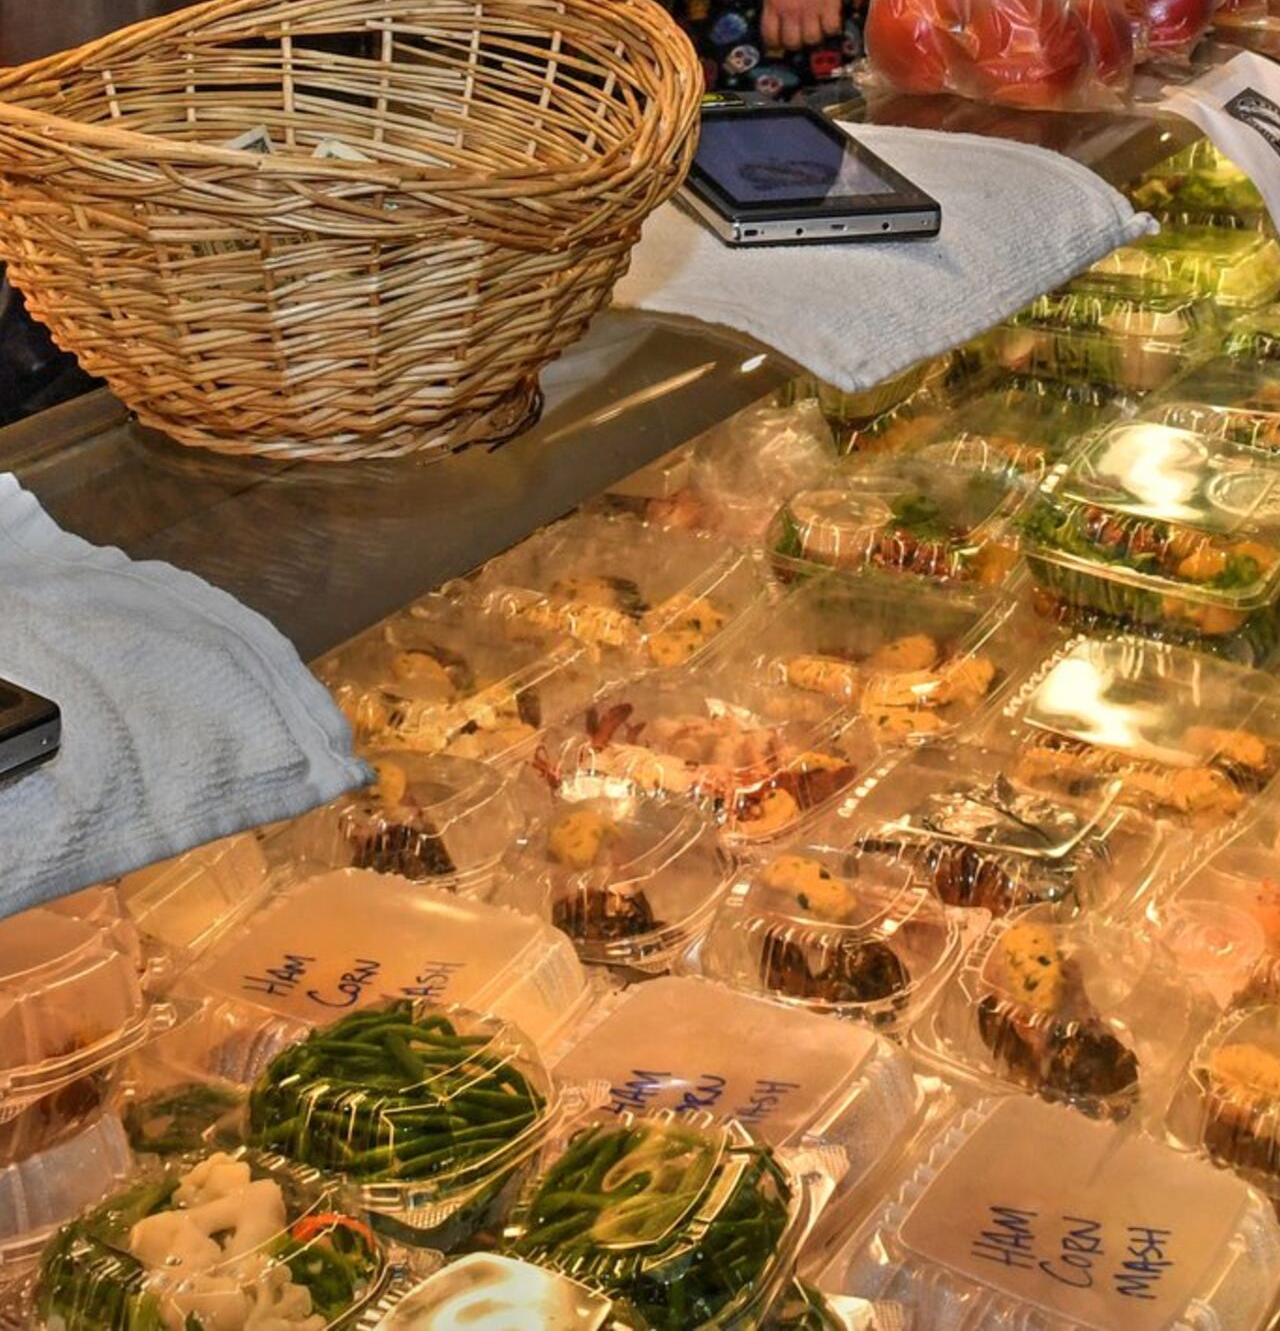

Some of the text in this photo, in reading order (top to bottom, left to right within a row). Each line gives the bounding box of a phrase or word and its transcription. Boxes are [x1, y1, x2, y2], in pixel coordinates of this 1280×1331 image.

[242, 954, 317, 997] HAM
[306, 958, 381, 1008] CORN
[381, 960, 466, 1002] ASH
[733, 1080, 801, 1123] ASH
[971, 1206, 1038, 1269] HAM
[1038, 1216, 1104, 1288] CORN
[1114, 1226, 1173, 1300] MASH
